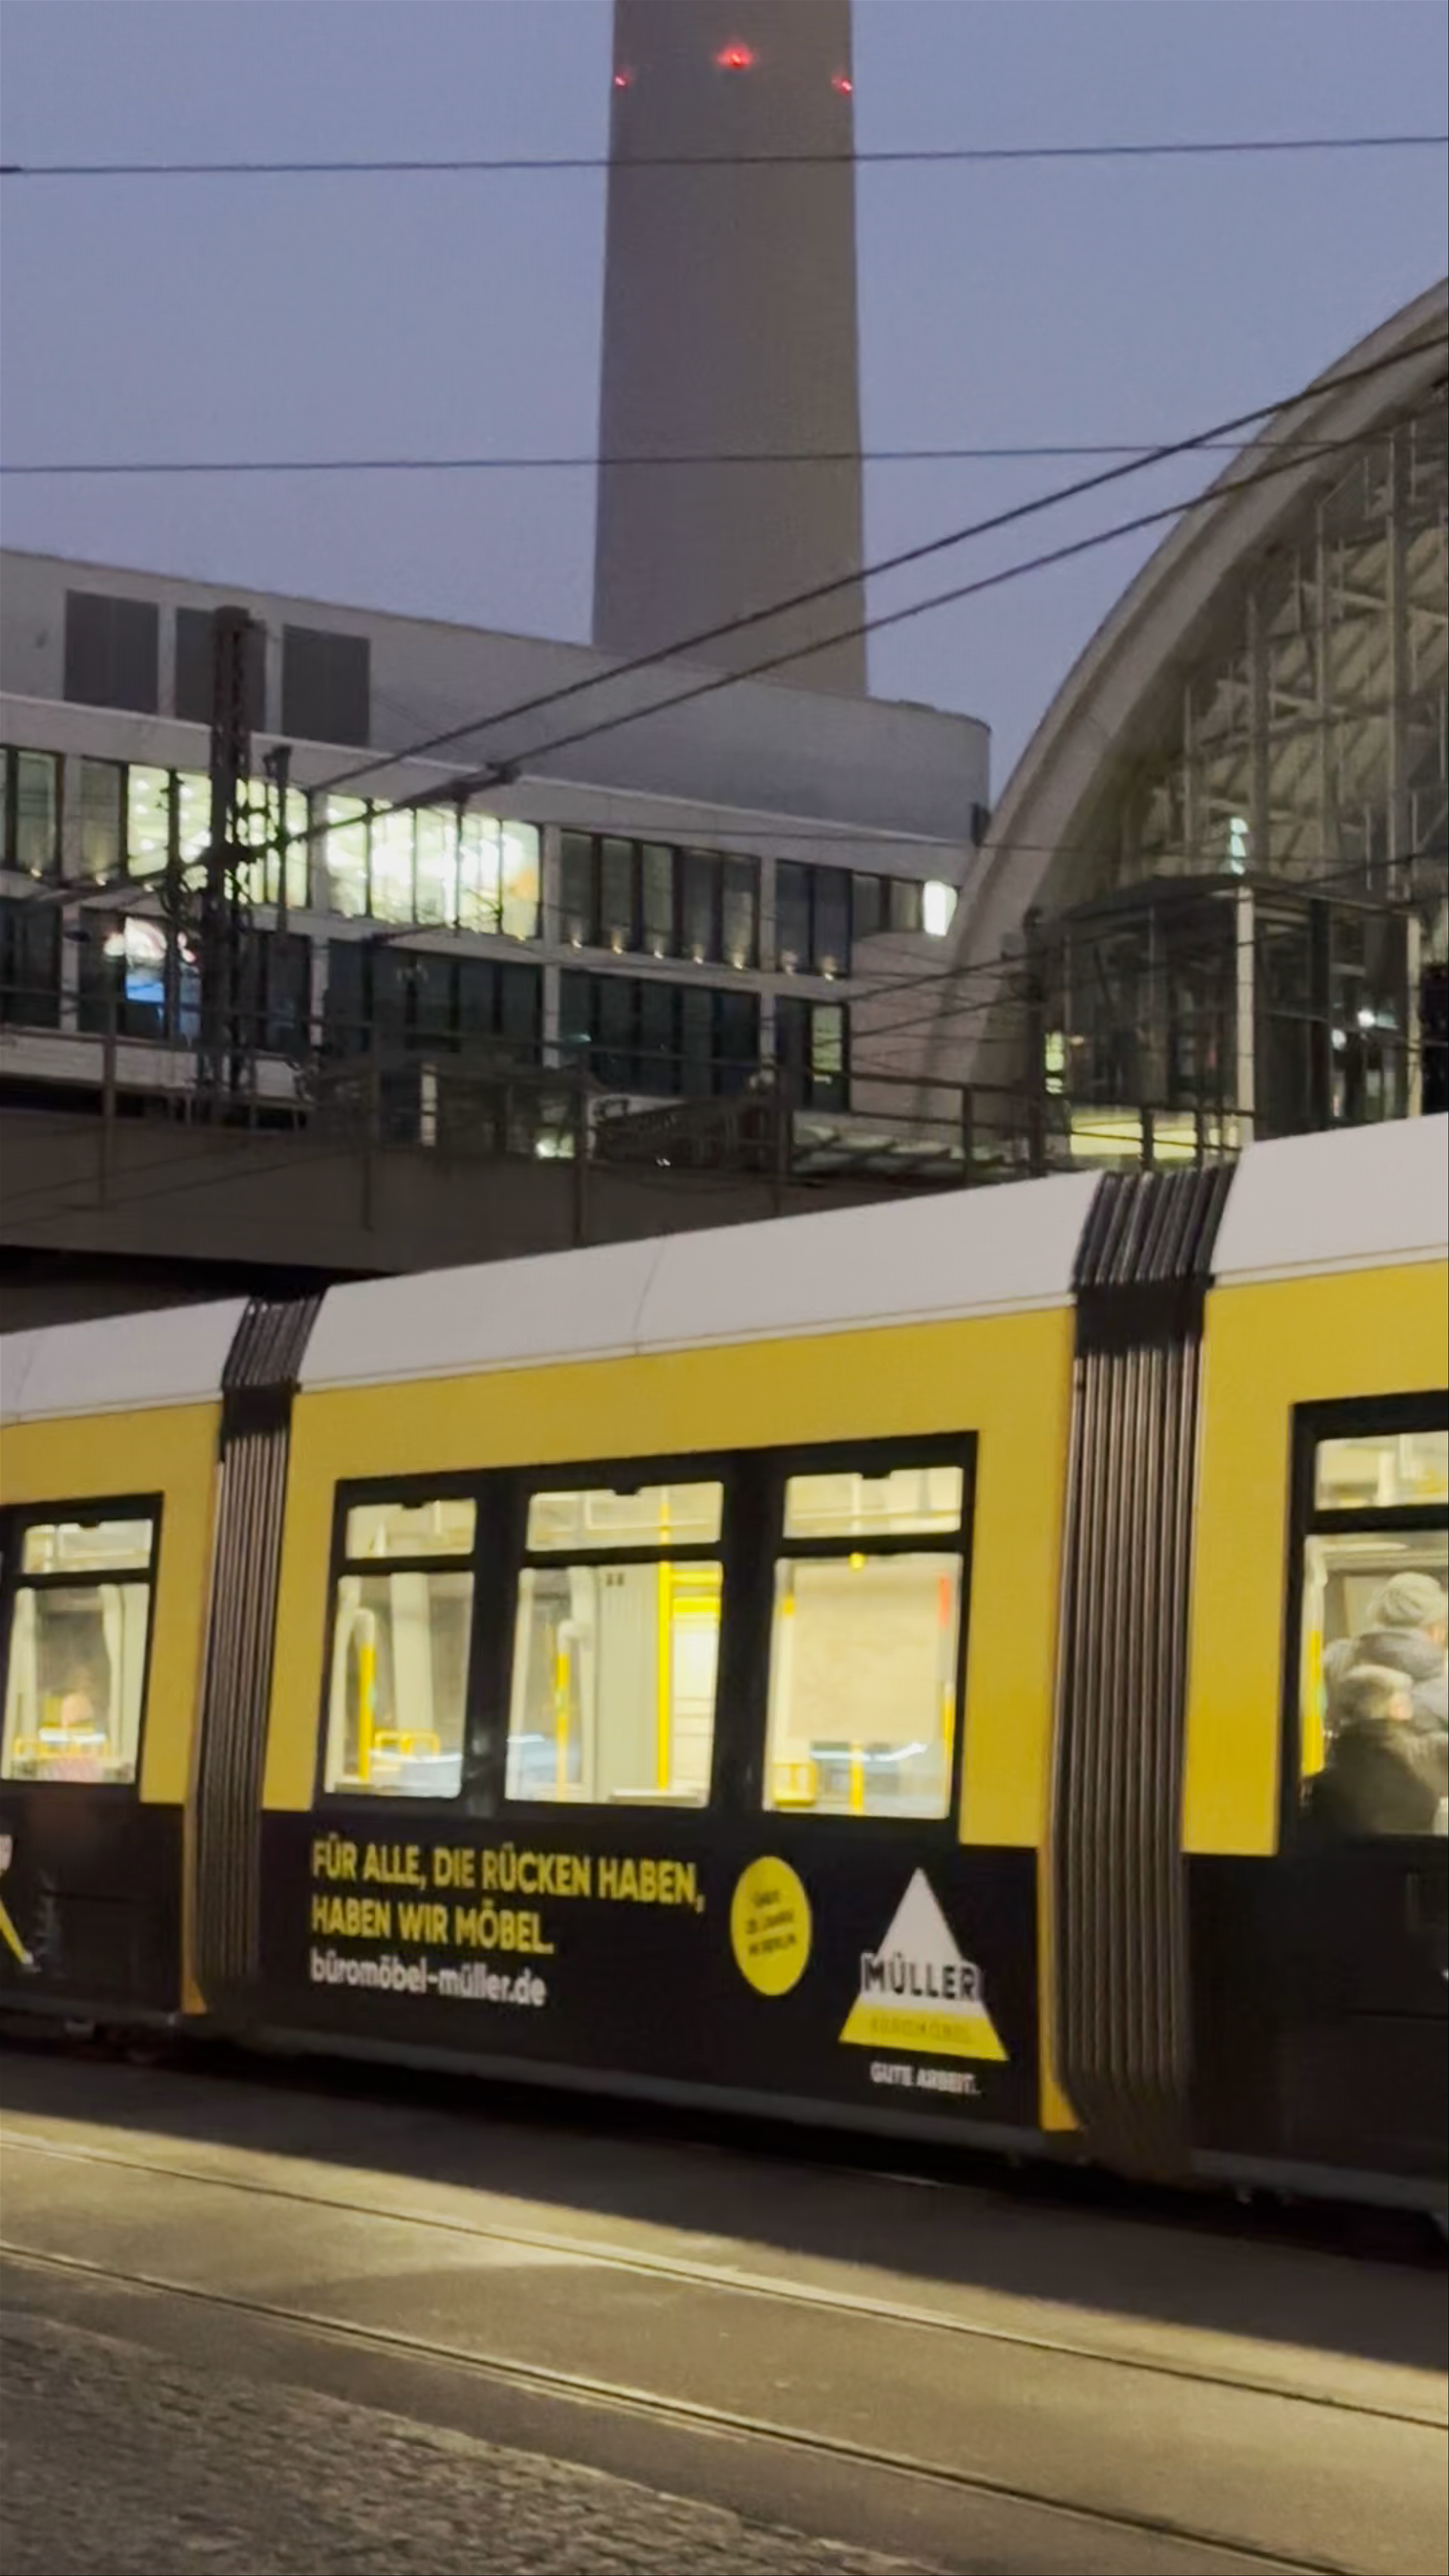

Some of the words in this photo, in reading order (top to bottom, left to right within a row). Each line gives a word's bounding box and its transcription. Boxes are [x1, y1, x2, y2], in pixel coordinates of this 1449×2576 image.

[313, 1833, 356, 1880] FÜR
[364, 1843, 426, 1890] ALLE,
[434, 1847, 475, 1888] DIE
[483, 1841, 591, 1896] RÜCKEN
[599, 1856, 705, 1912] HABEN,
[312, 1895, 391, 1937] HABEN
[398, 1902, 448, 1944] WIR
[455, 1899, 554, 1954] MÖBEL.
[311, 1947, 546, 2006] büromöbel-müller.de
[863, 1952, 978, 2001] MÜLLER
[871, 2061, 914, 2087] GUTE
